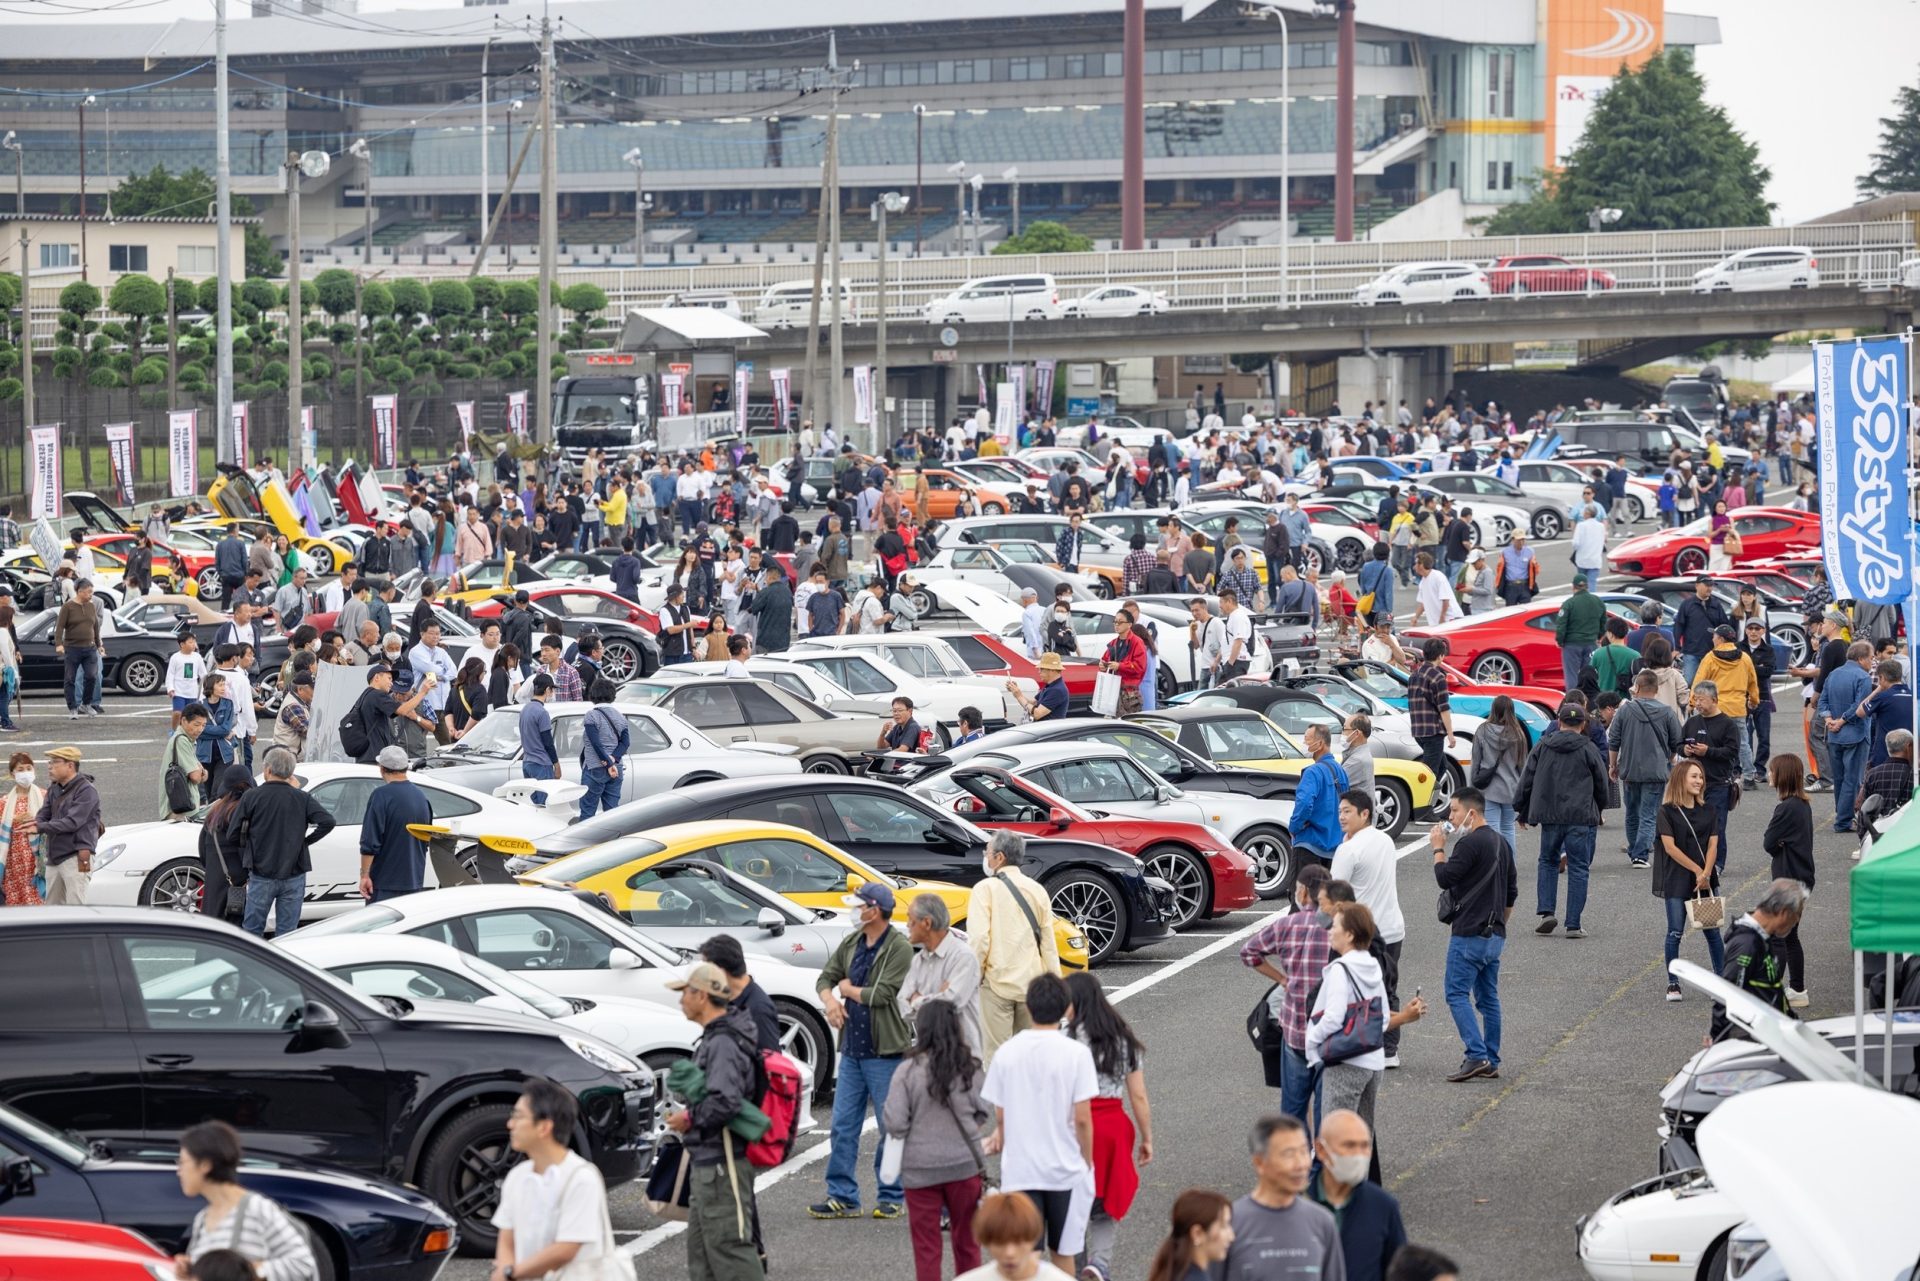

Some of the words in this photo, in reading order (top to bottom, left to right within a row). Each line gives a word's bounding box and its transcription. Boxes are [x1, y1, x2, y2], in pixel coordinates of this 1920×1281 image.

[1822, 354, 1832, 398] Print
[1823, 420, 1834, 472] design
[1840, 347, 1903, 600] 39style
[1826, 481, 1836, 525] Print
[1828, 546, 1845, 592] design
[493, 840, 530, 849] ACCENT
